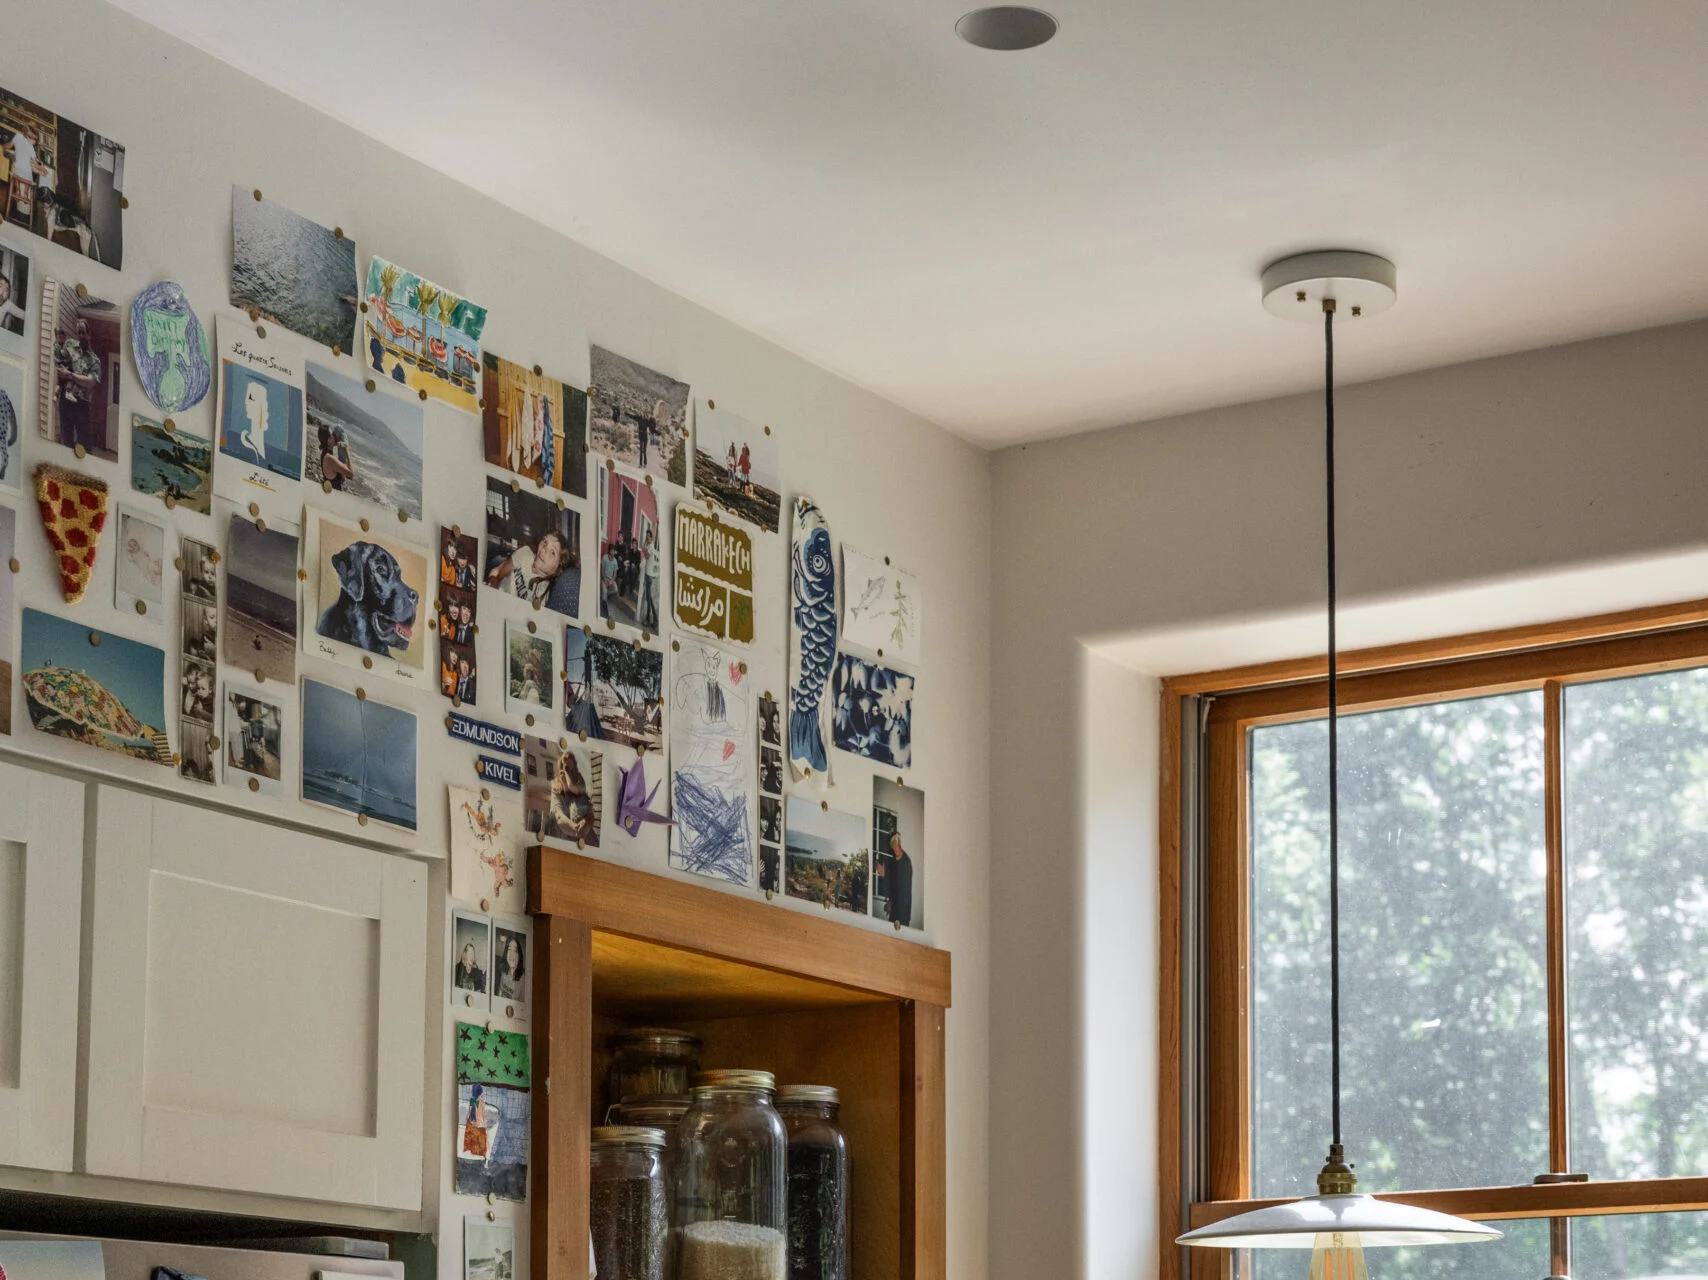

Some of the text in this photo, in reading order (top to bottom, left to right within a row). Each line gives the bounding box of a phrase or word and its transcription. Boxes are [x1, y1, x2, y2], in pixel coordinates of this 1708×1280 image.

[679, 514, 751, 575] MARRAKECH
[452, 719, 519, 752] EDMUNDSON
[485, 761, 518, 784] KIVEL
